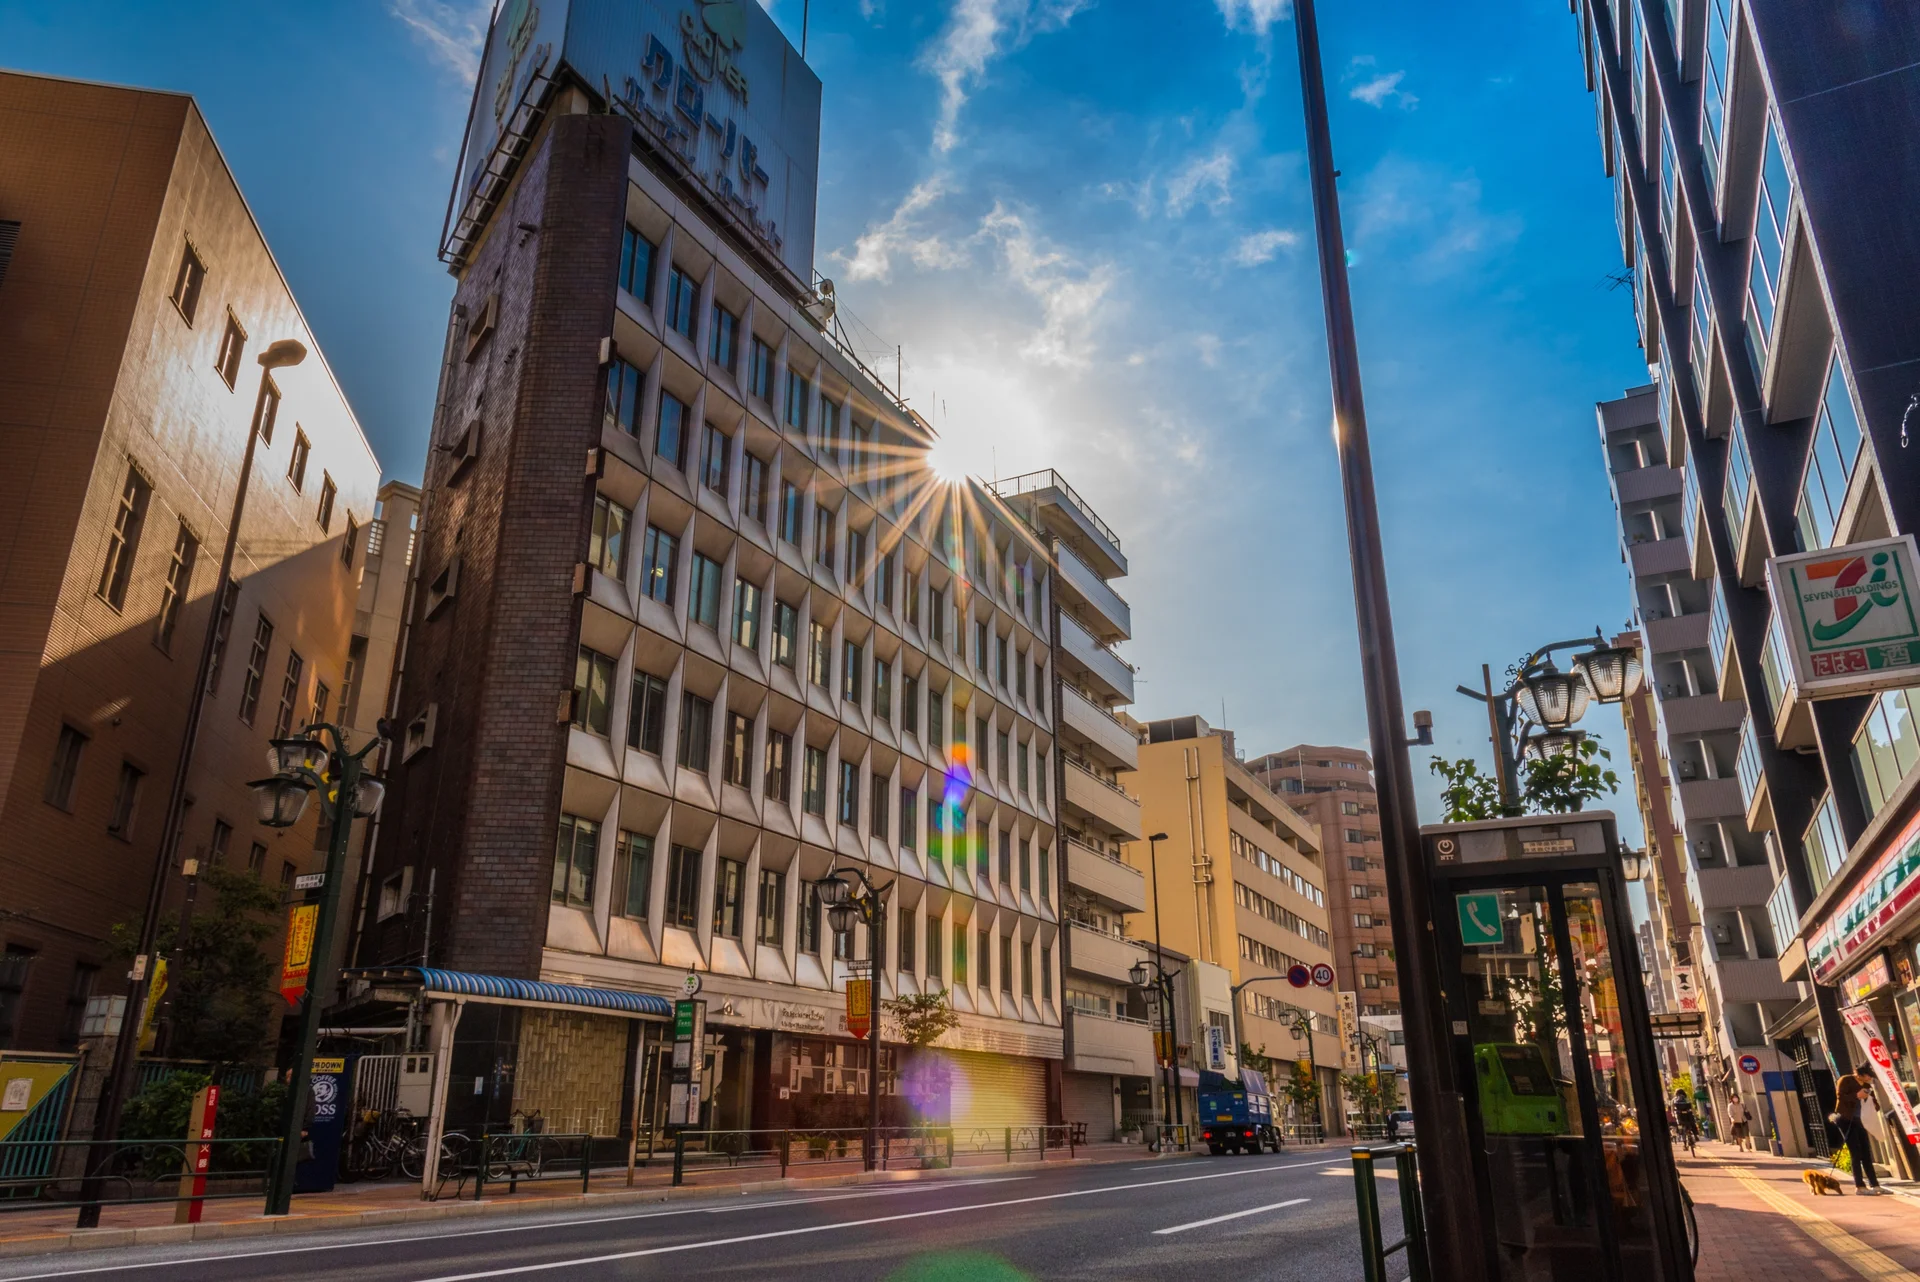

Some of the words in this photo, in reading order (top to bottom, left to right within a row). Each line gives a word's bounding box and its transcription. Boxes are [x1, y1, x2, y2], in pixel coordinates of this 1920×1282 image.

[642, 32, 770, 187] クローバー
[1847, 580, 1899, 597] HOLDINGS
[1813, 651, 1865, 674] たばこ
[1879, 645, 1911, 667] 酒
[1315, 969, 1330, 981] 40
[311, 1074, 337, 1084] COFFEE
[315, 1103, 337, 1116] OSS
